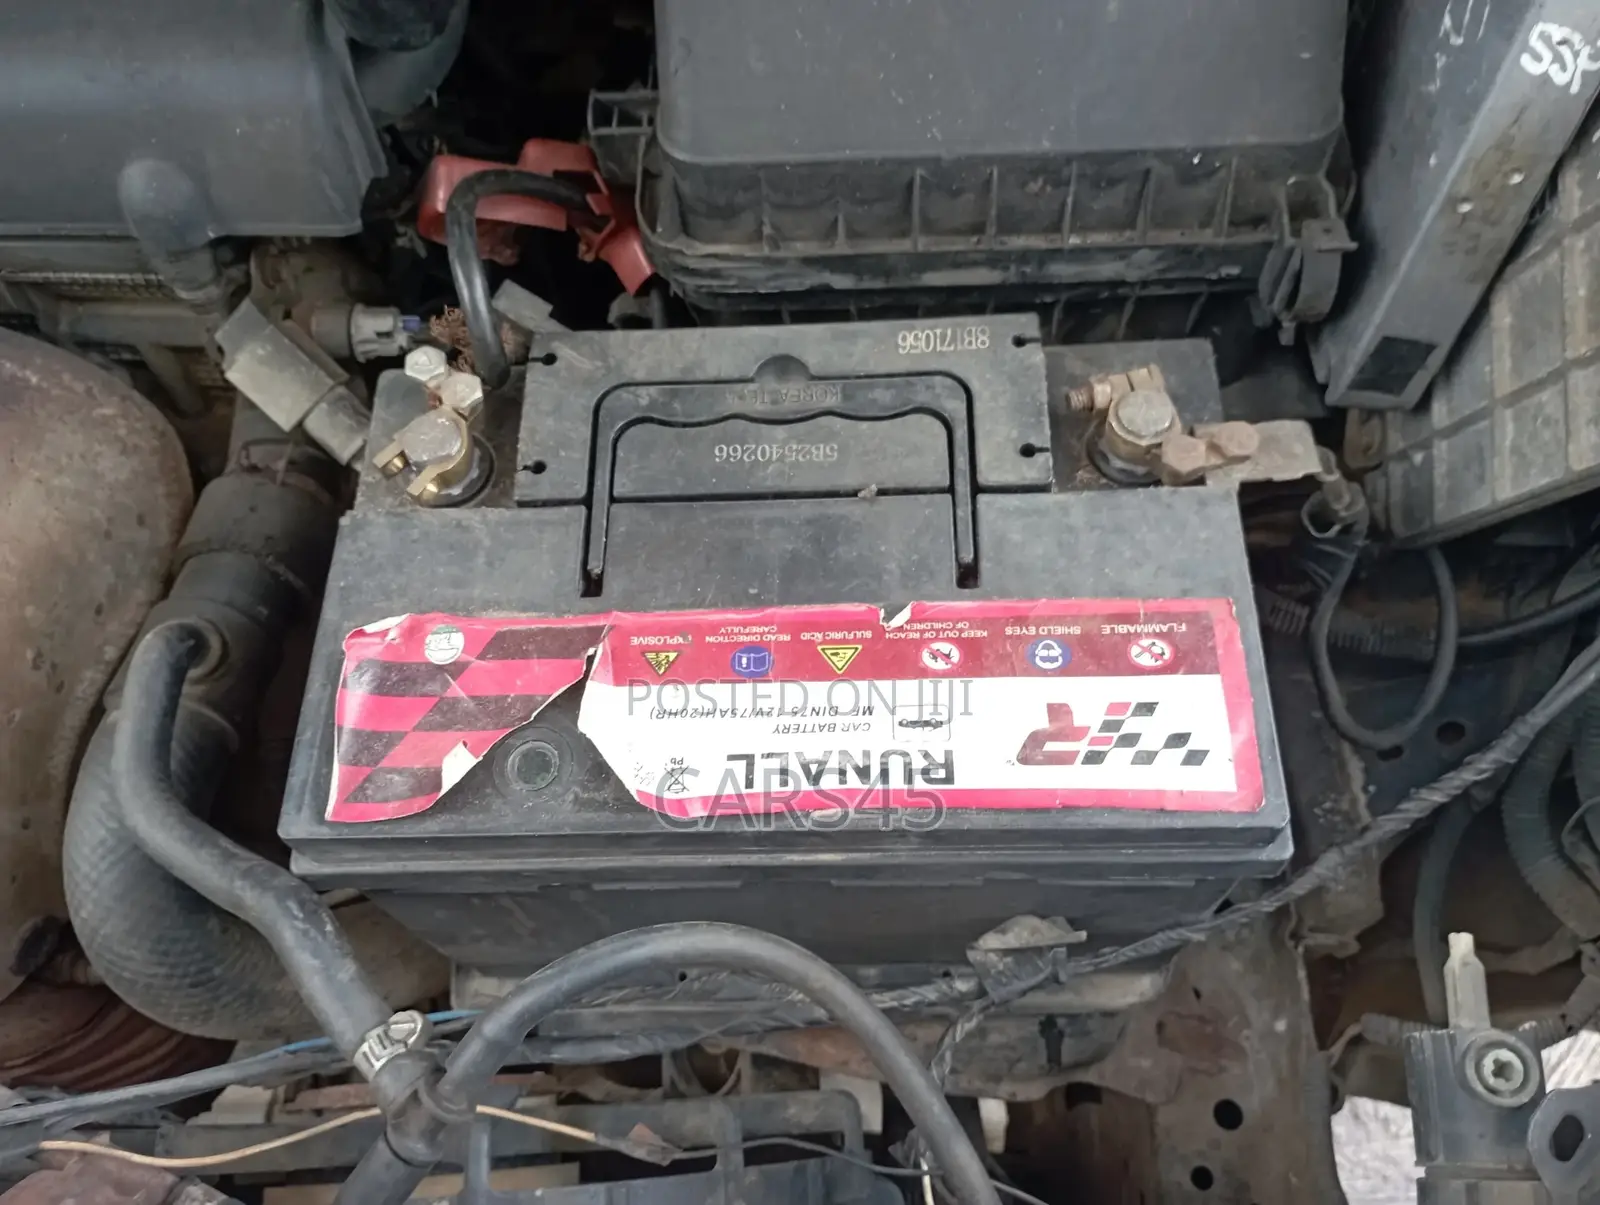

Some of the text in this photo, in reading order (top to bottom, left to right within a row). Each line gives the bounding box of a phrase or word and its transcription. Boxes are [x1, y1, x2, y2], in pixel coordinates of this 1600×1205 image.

[778, 385, 843, 404] KOREA
[714, 443, 839, 462] 5B2540266
[718, 625, 777, 634] CAREFULLY
[902, 621, 970, 631] OF CHILDREN
[1004, 625, 1082, 636] SHIELD EYES
[1101, 622, 1187, 635] FLAMMABLE
[705, 633, 791, 643] READ DIRECTION
[800, 630, 873, 642] SULFURIC ACID
[885, 629, 988, 640] KEEP OUT OF REACH
[772, 722, 871, 735] CAR BATTERY
[670, 756, 685, 767] Pb
[727, 750, 955, 790] RUNALL
